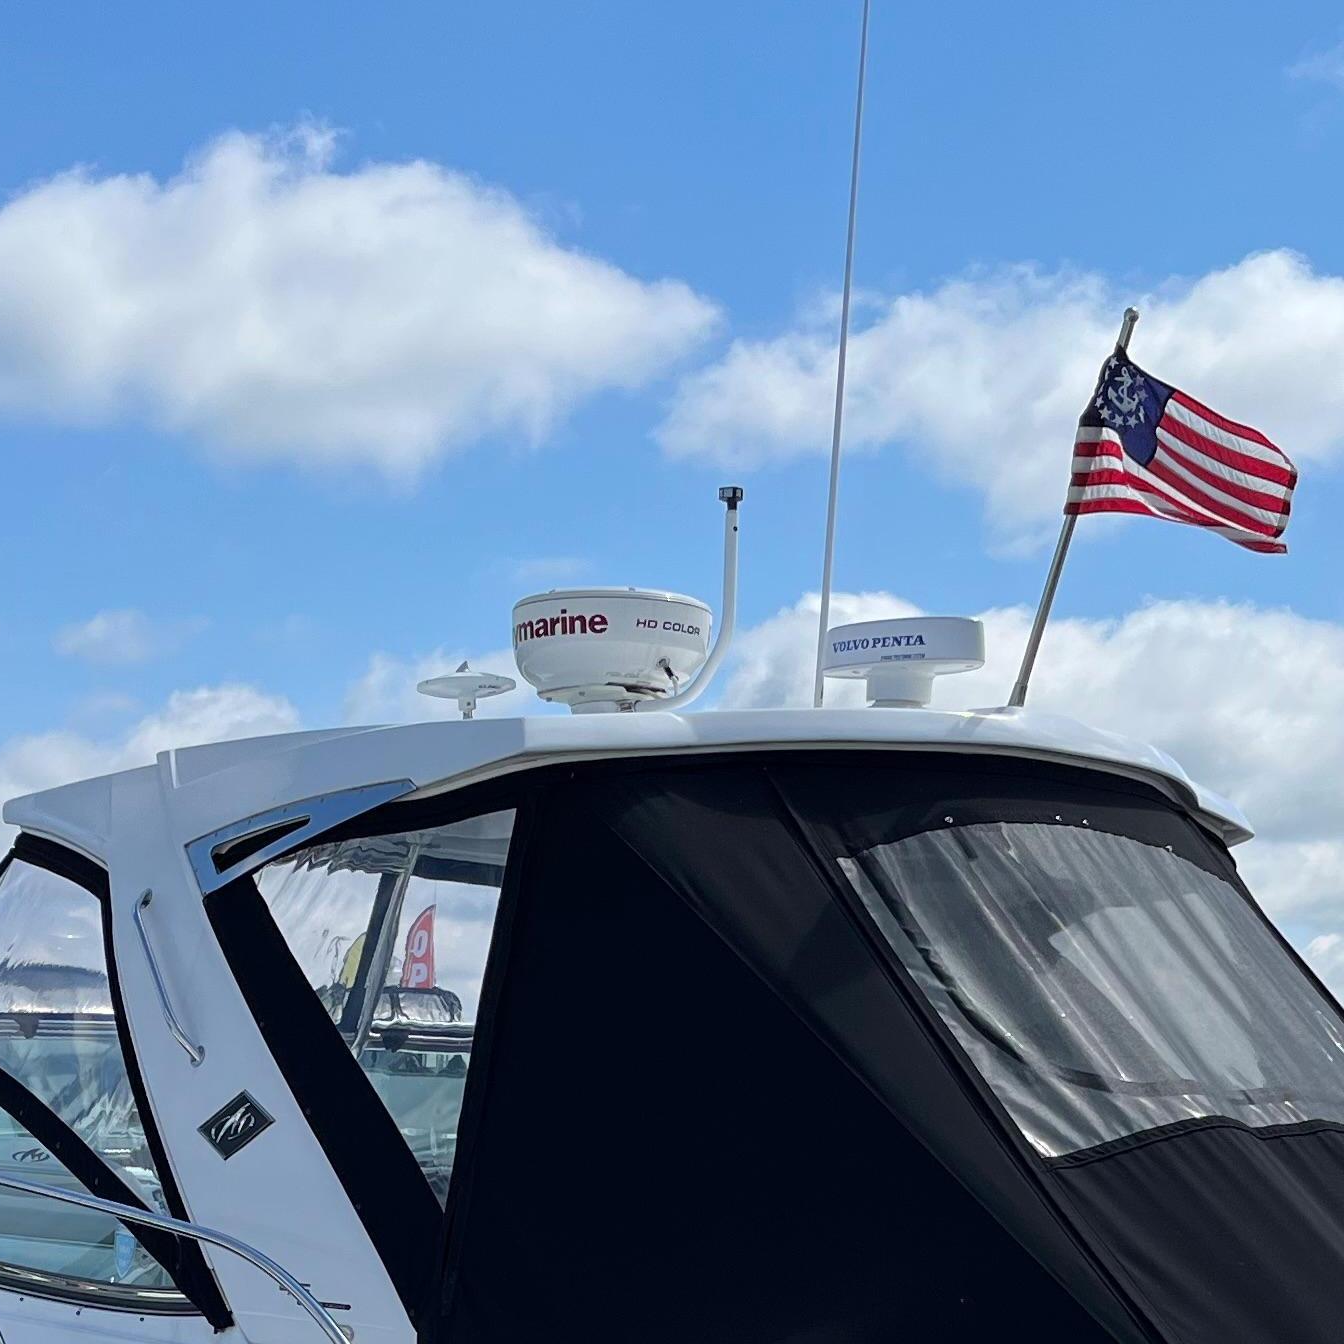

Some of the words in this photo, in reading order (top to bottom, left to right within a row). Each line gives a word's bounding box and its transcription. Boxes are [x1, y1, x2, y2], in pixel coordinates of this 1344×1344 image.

[636, 618, 658, 629] HD
[662, 621, 701, 636] COLOR
[832, 638, 869, 653] VOLVO
[871, 634, 926, 649] PENTA
